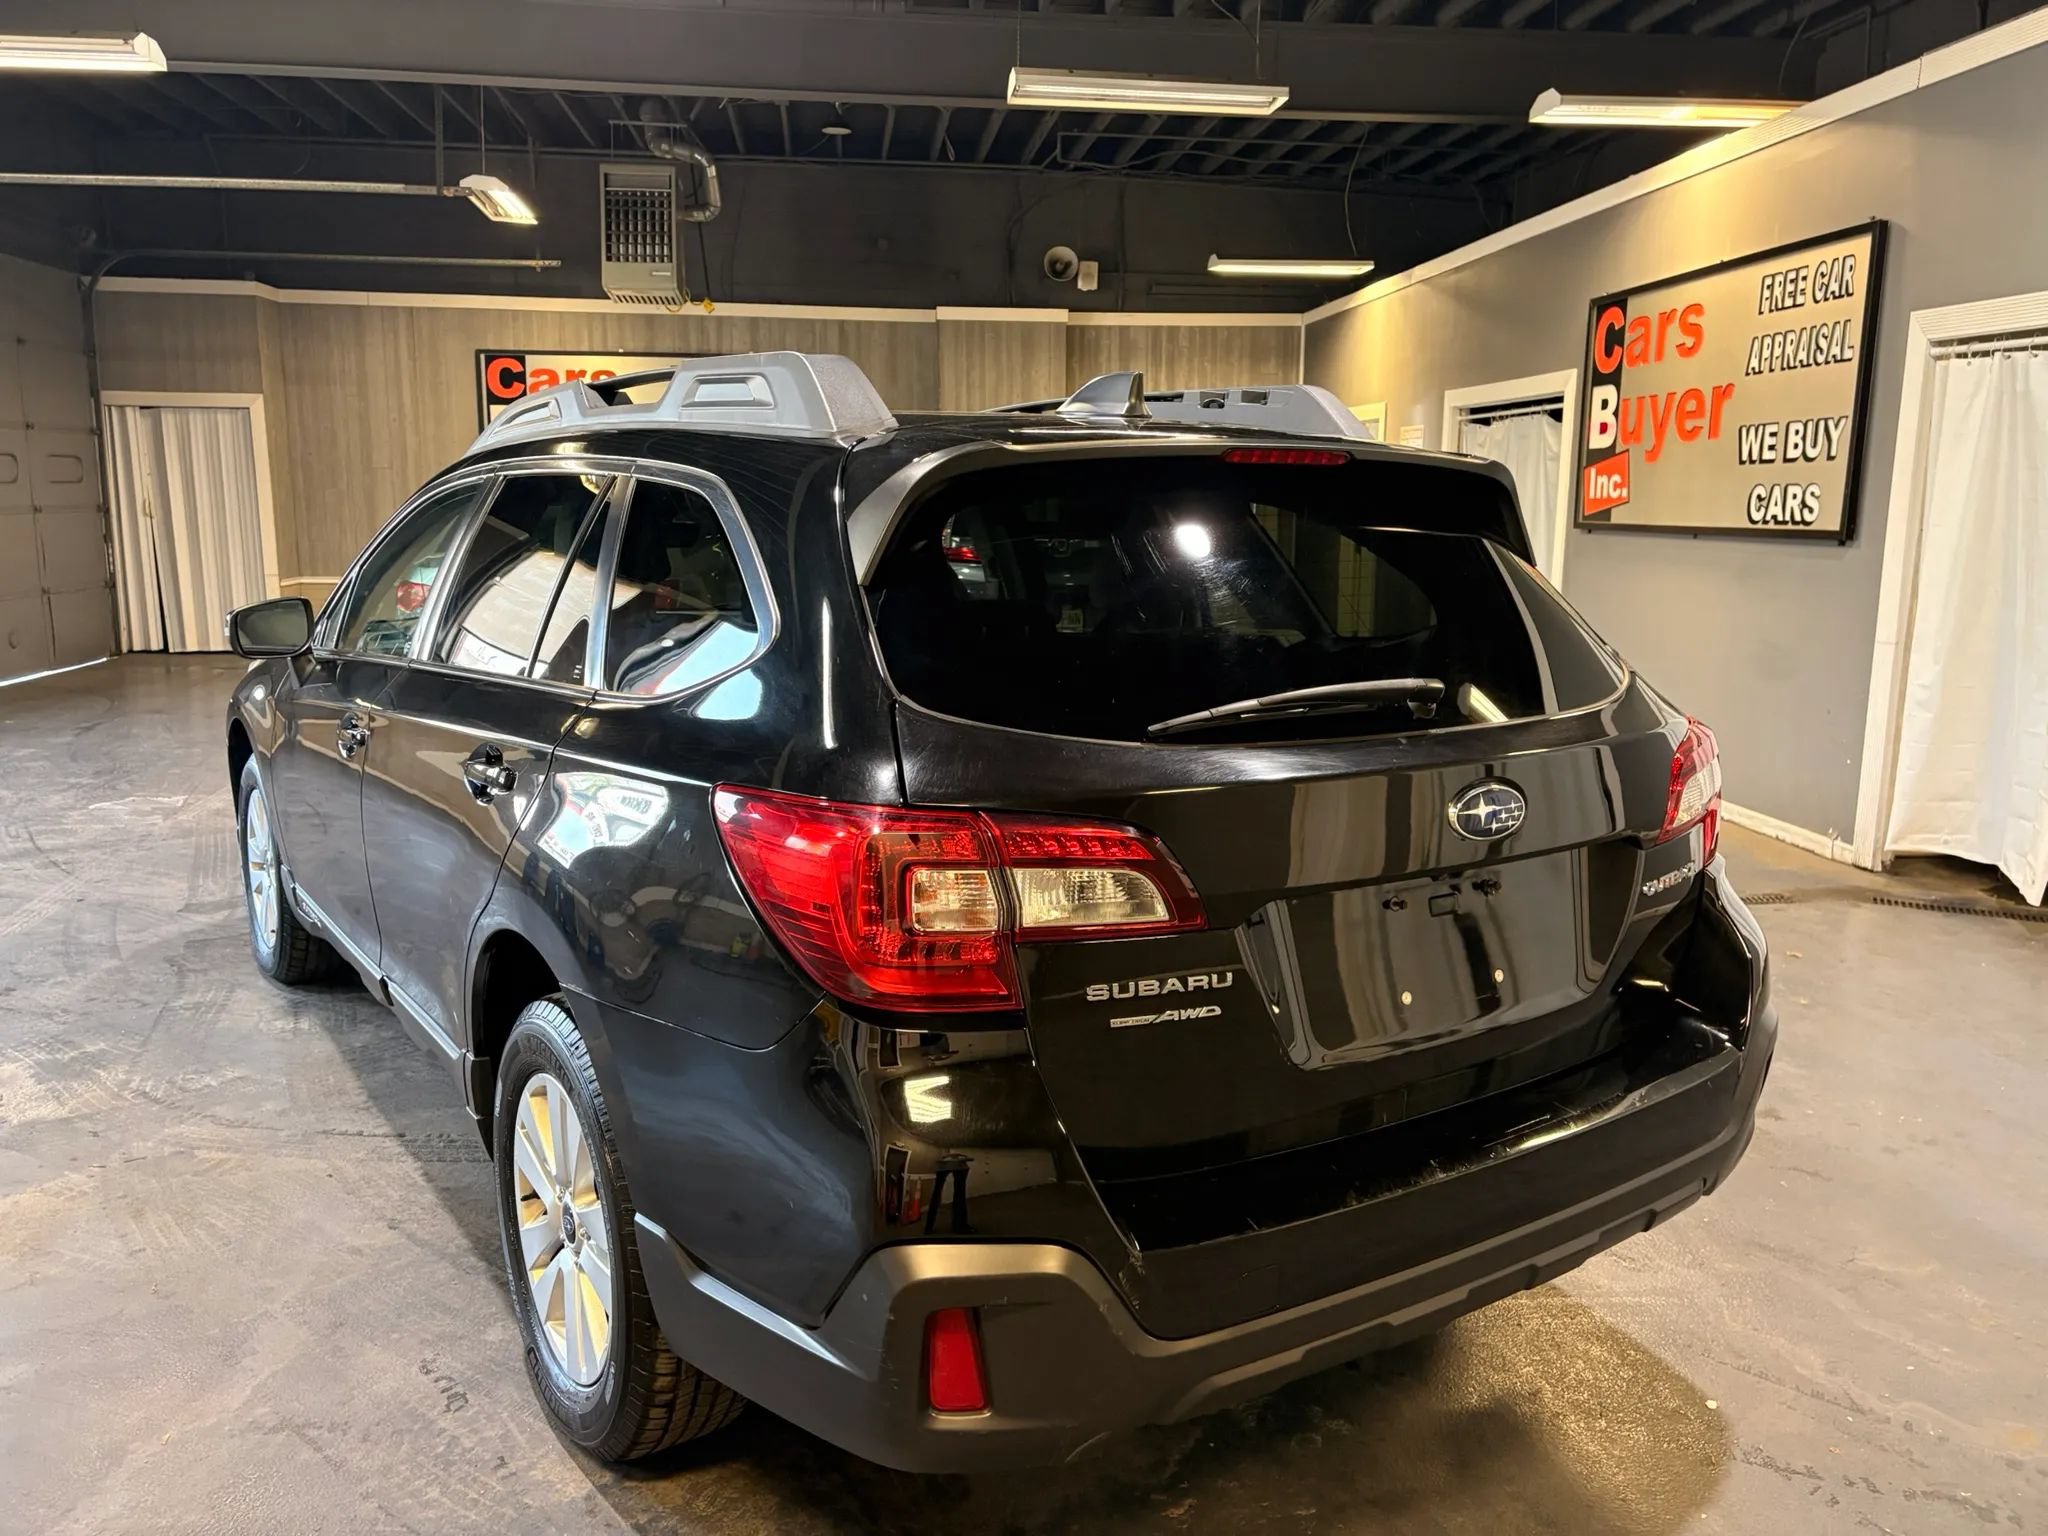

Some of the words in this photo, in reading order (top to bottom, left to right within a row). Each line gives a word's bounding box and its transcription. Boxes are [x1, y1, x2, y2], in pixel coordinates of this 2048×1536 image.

[1758, 265, 1809, 315] FREE
[1812, 254, 1856, 303] CAR
[1594, 303, 1705, 374] Cars
[1745, 319, 1854, 376] APPRAISAL
[1588, 383, 1735, 463] Buyer
[1739, 423, 1778, 464] WE
[1783, 417, 1848, 463] BUY
[1588, 468, 1629, 499] Inc.
[1747, 483, 1821, 526] CARS
[1086, 972, 1233, 1001] SUBARU
[1153, 1005, 1222, 1024] AWD
